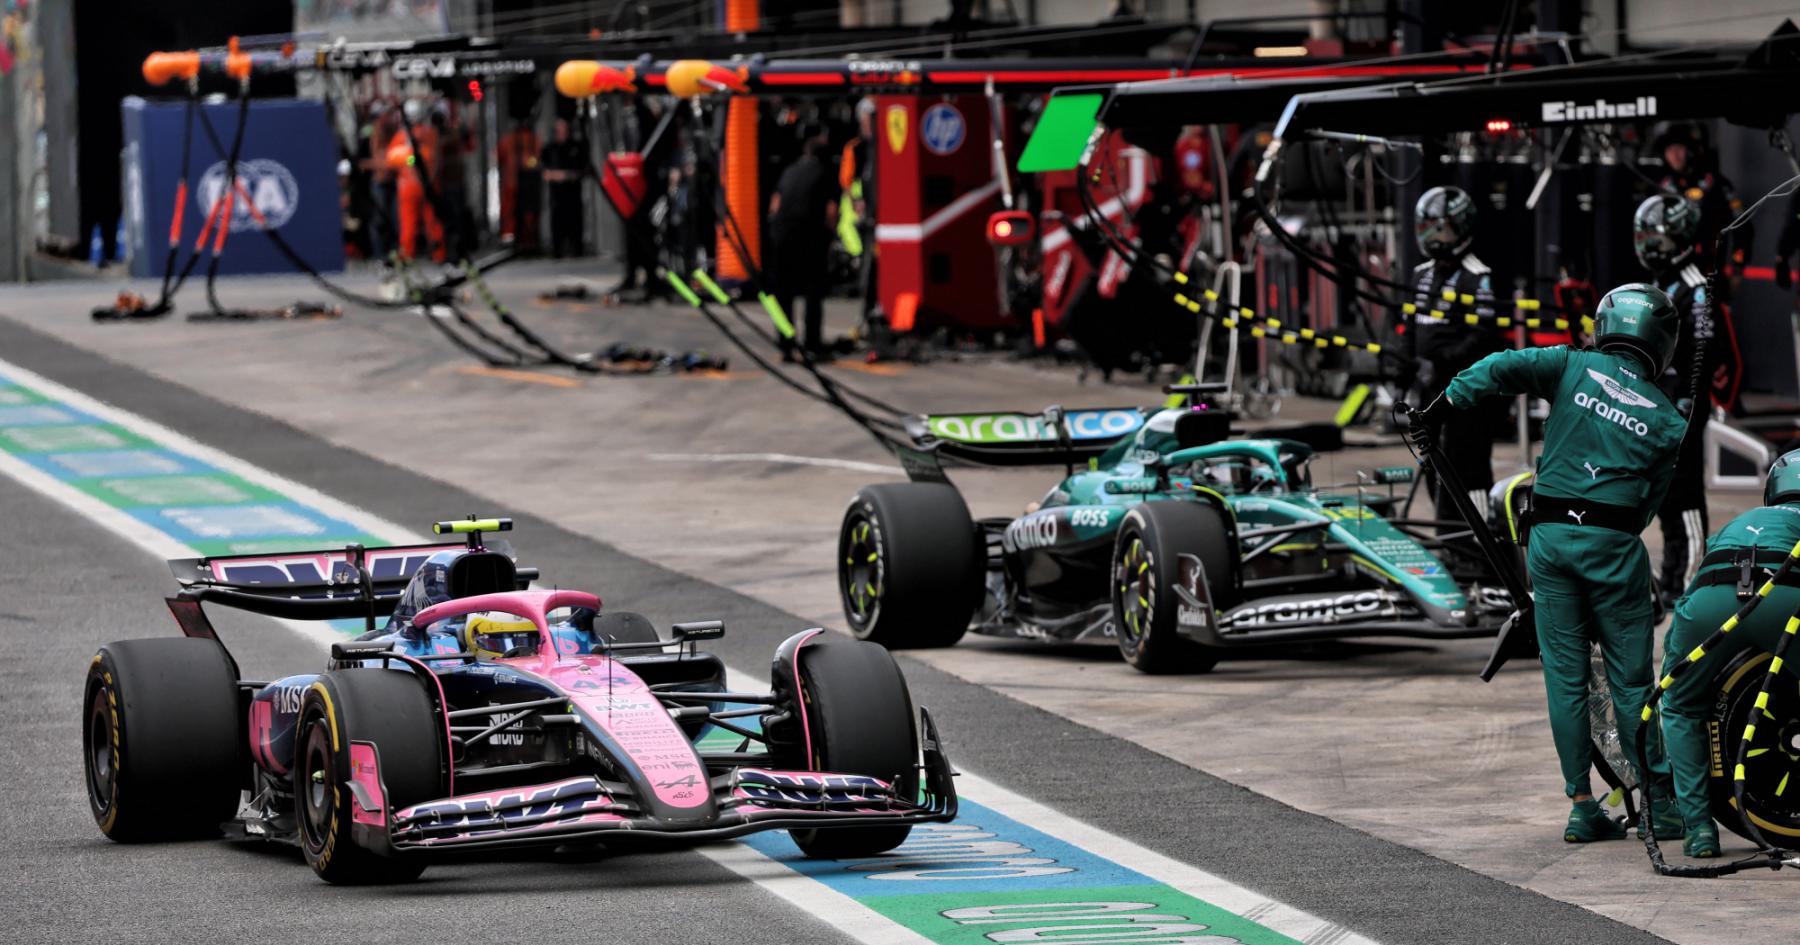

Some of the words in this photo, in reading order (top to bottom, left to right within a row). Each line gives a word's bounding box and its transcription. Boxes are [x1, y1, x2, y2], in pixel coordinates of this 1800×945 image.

[1541, 96, 1657, 122] Einhell
[1574, 391, 1648, 436] aramco
[1071, 509, 1111, 527] BOSS
[1232, 591, 1380, 627] aramco
[1706, 720, 1724, 778] PIRELLI
